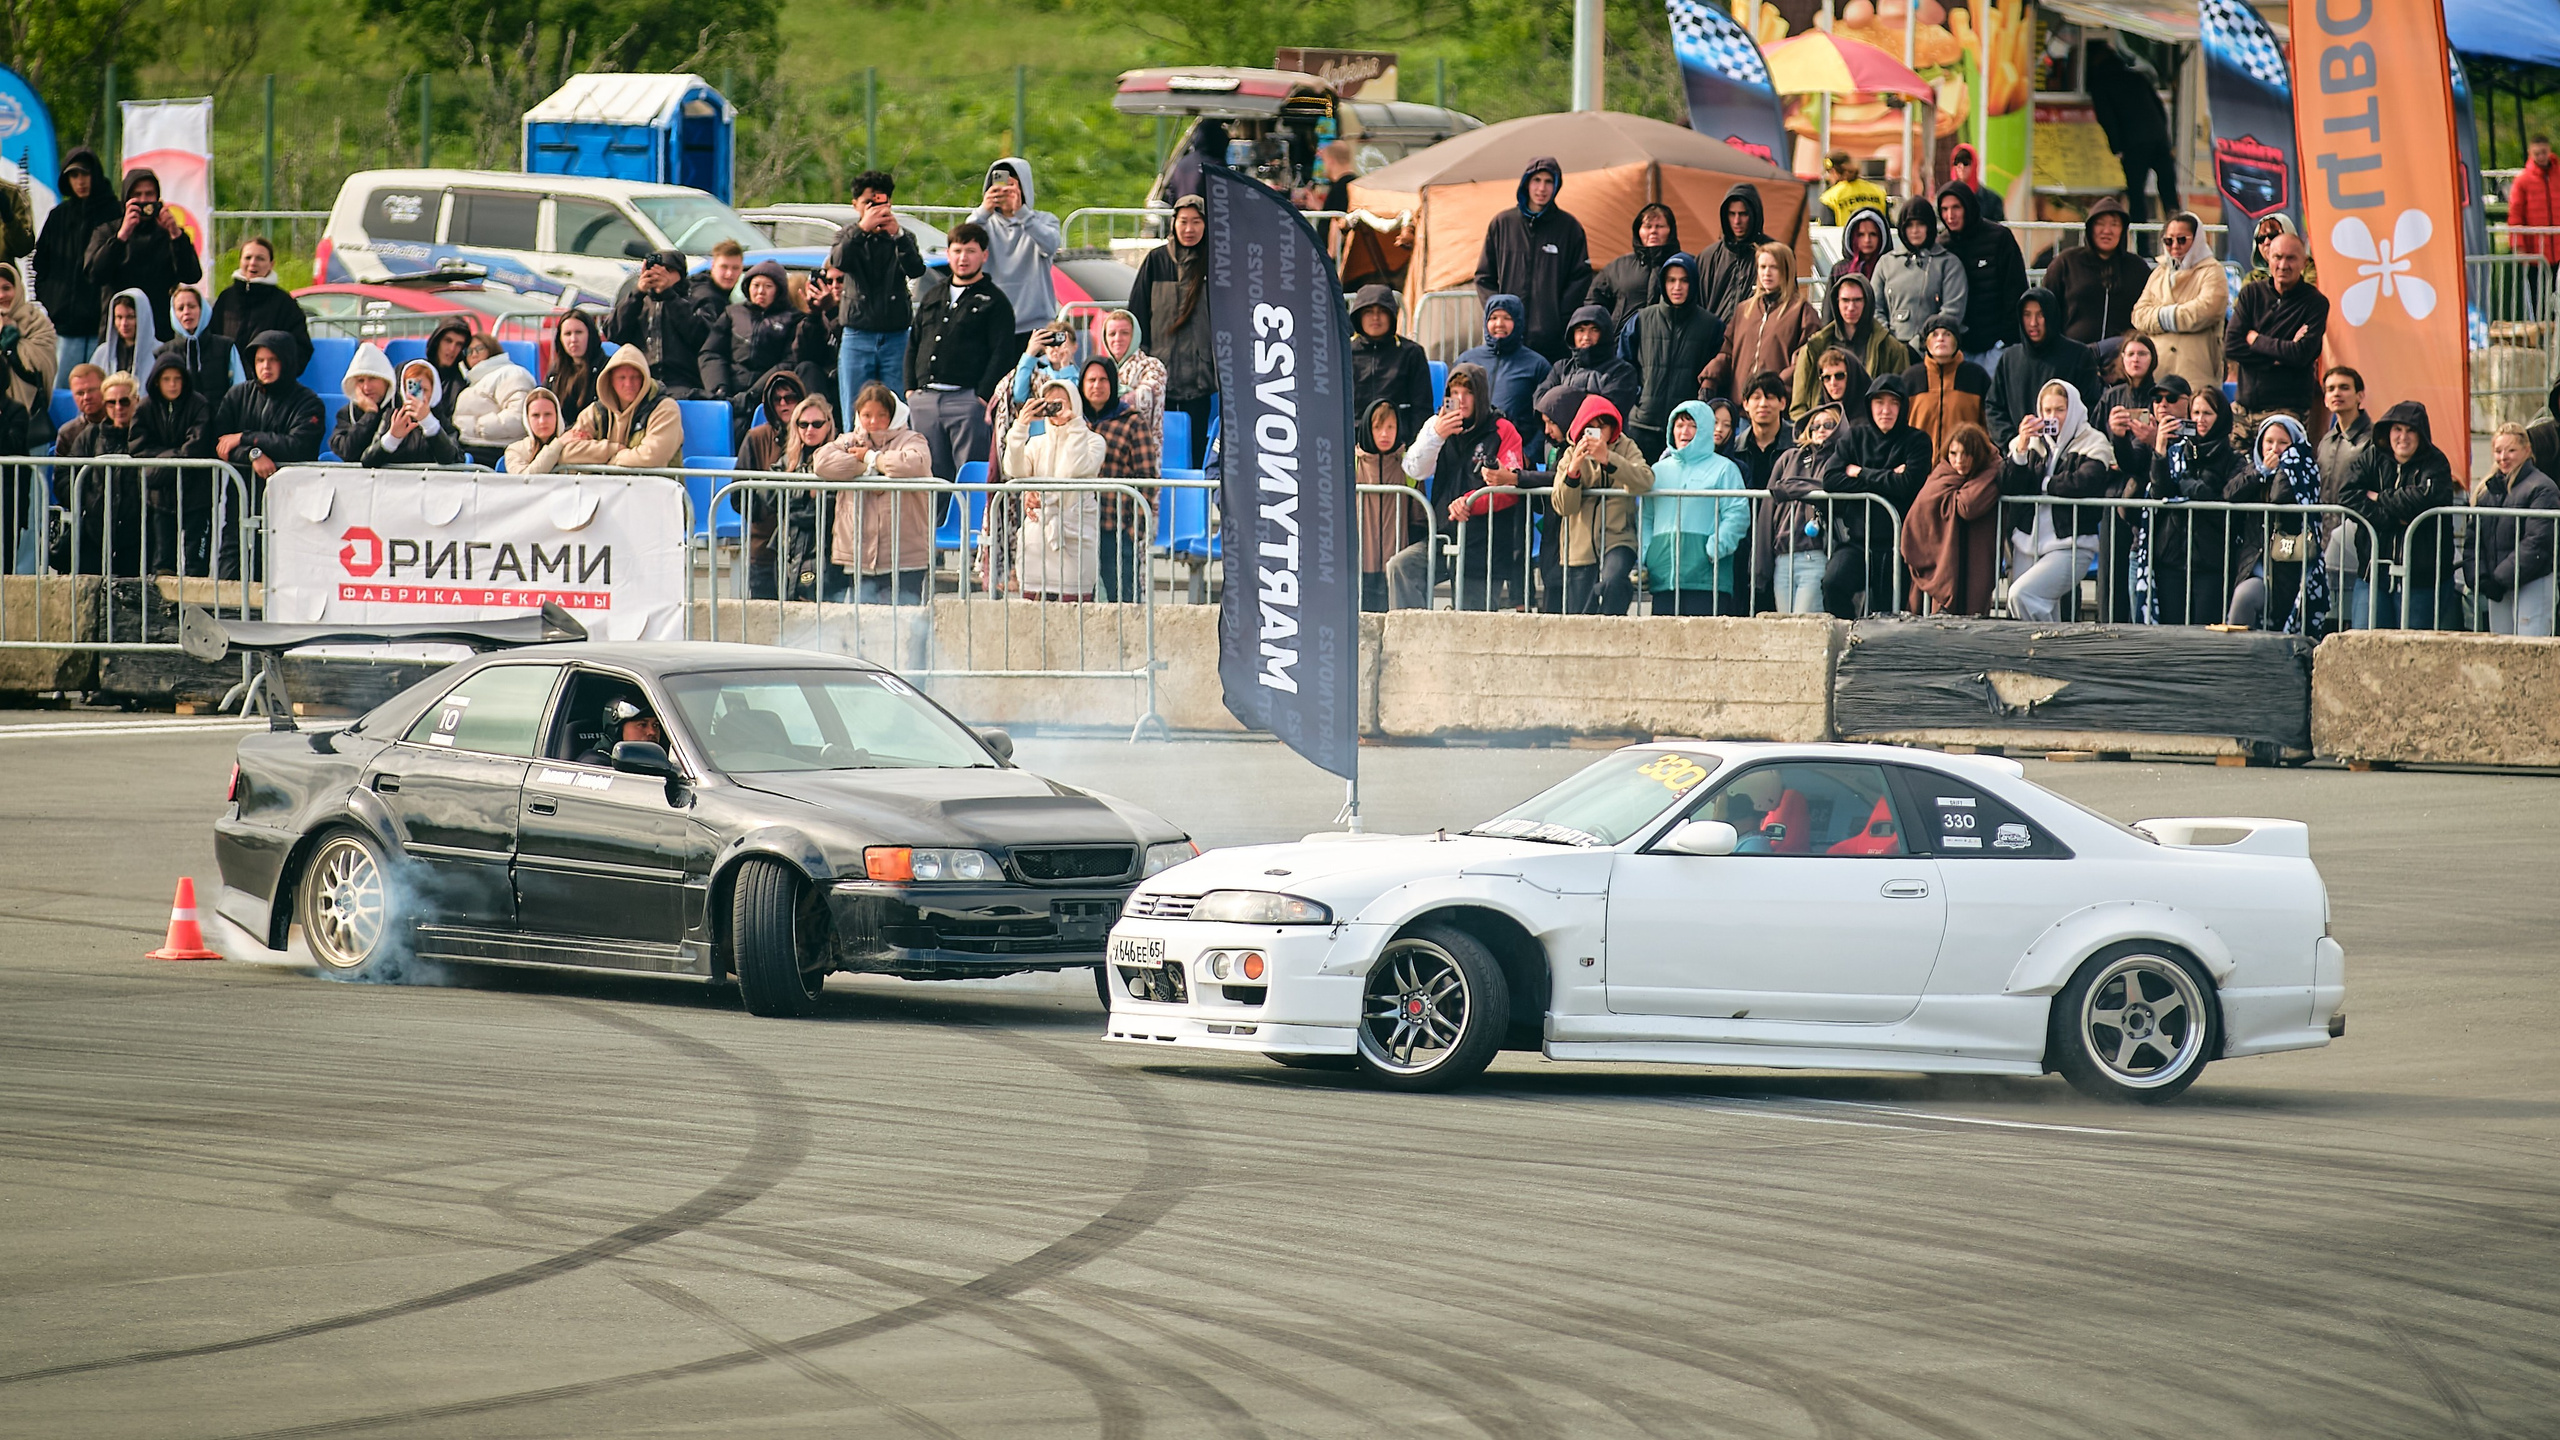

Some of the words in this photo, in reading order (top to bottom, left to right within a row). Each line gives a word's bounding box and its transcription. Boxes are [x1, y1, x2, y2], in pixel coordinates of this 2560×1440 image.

[343, 587, 462, 604] ФАБРИКА
[484, 592, 607, 608] РЕКЛАМЫ
[867, 674, 912, 697] 10
[438, 708, 460, 731] 10
[1637, 753, 1707, 790] 330
[1944, 813, 1976, 829] 330
[1149, 941, 1161, 957] 65
